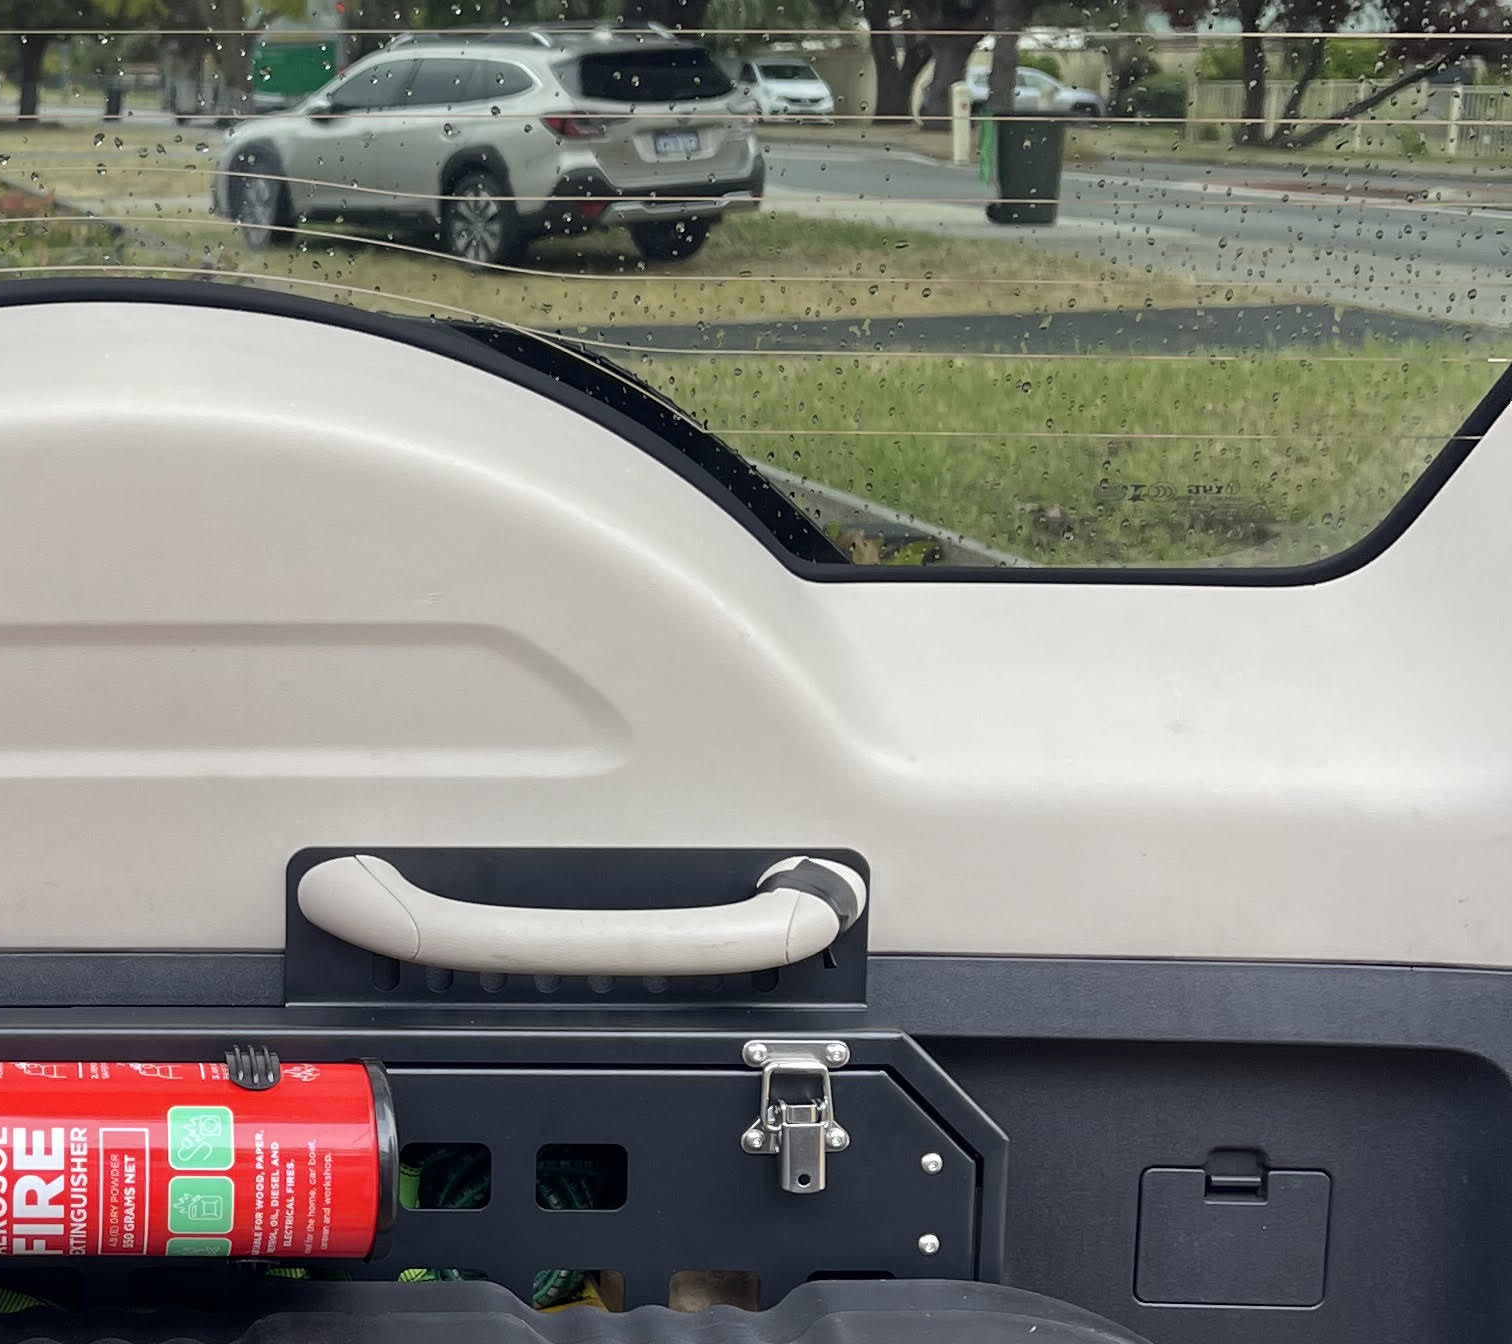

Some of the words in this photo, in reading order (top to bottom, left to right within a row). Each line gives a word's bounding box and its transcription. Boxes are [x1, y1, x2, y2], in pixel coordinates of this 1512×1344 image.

[124, 1154, 136, 1184] NET
[271, 1141, 279, 1167] AND
[13, 1127, 65, 1255] FIRE
[70, 1127, 88, 1255] EXTINGUISHER
[110, 1153, 119, 1203] POWDER
[255, 1171, 265, 1210] WOOD,
[271, 1169, 279, 1207] DIESEL
[286, 1159, 295, 1194] FIRES.
[308, 1168, 316, 1185] car
[110, 1204, 119, 1224] DRY
[123, 1187, 135, 1232] GRAMS
[254, 1212, 263, 1230] FOR
[270, 1209, 280, 1227] OIL,
[284, 1196, 295, 1247] ELECTRICAL
[306, 1219, 315, 1232] the
[321, 1207, 331, 1225] and
